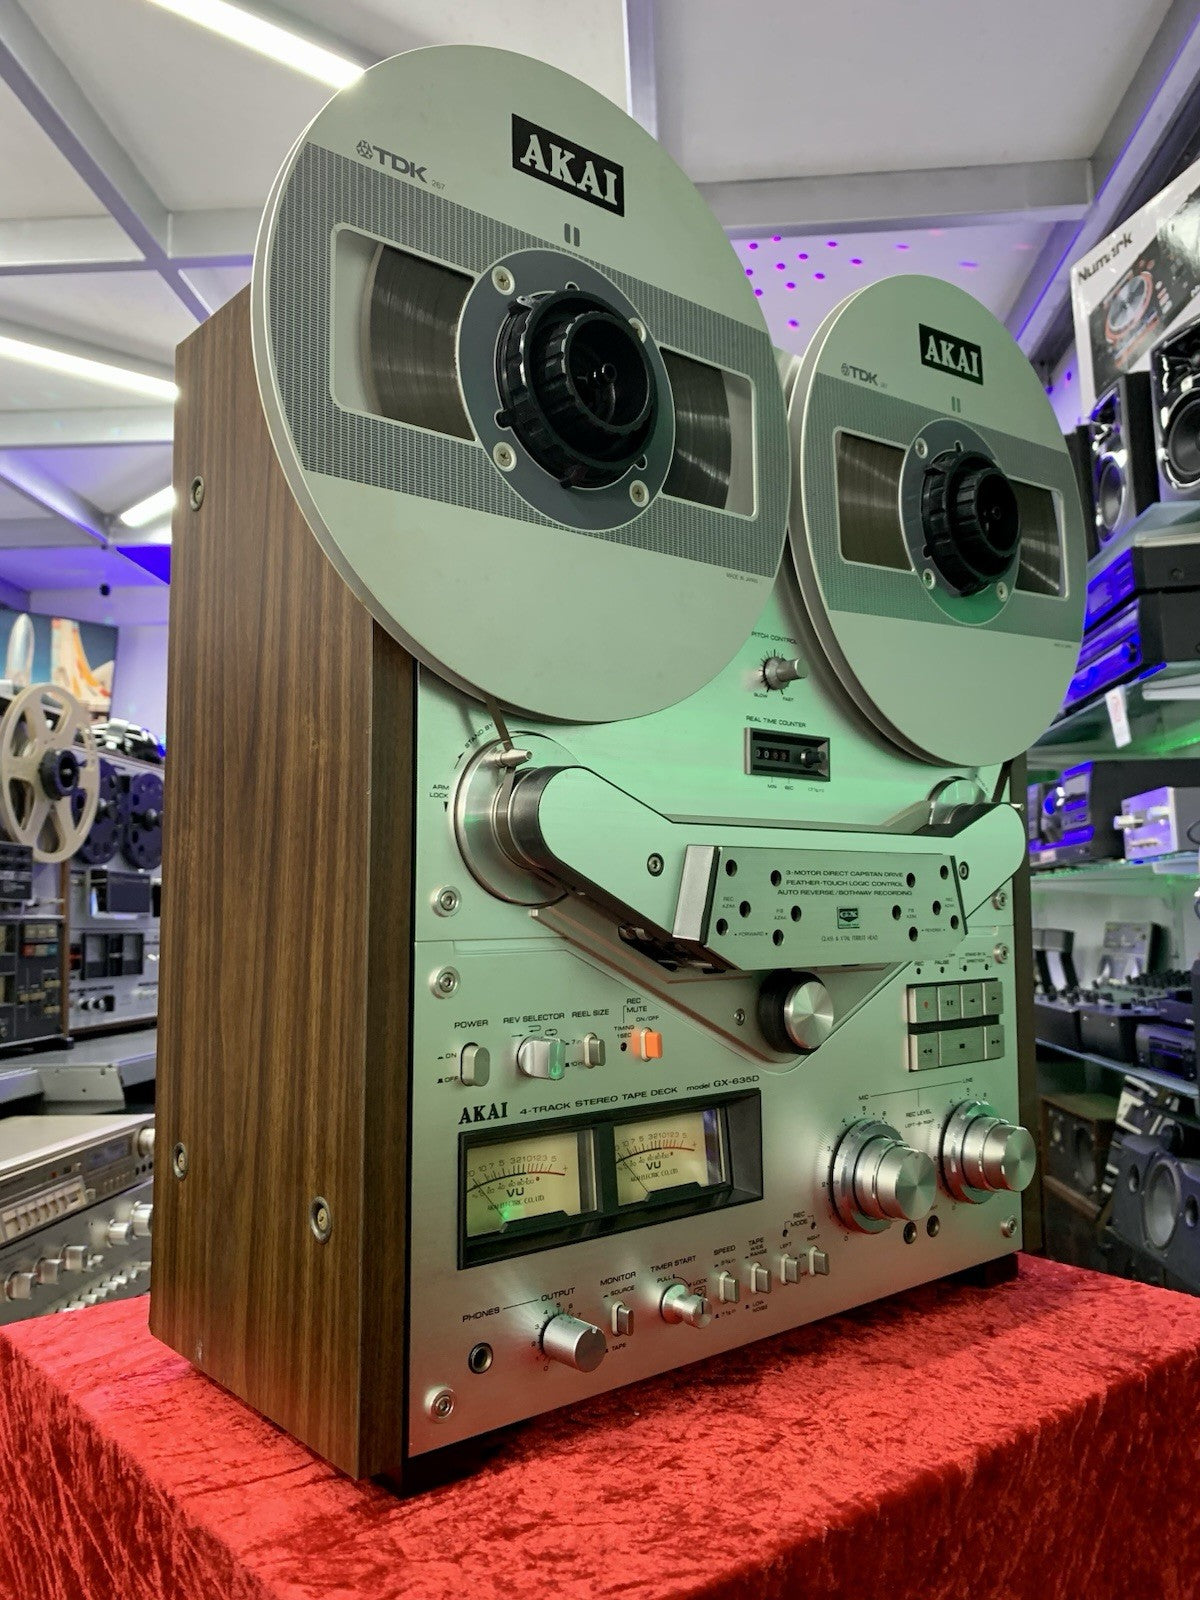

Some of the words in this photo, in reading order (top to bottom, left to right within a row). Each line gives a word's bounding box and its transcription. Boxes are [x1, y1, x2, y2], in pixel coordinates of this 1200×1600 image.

[373, 145, 427, 183] TDK
[520, 134, 617, 206] AKAI
[925, 335, 979, 378] AKAI
[849, 365, 878, 386] TDK
[751, 631, 769, 639] PITCH
[770, 635, 797, 644] CONTROL
[746, 715, 761, 723] REAL
[763, 717, 777, 725] TIME
[779, 719, 807, 728] COUNTER
[465, 728, 484, 749] STAND
[572, 1010, 591, 1018] REEL
[593, 1008, 610, 1016] SIZE
[627, 1005, 648, 1013] MUTE
[503, 1016, 521, 1024] REV
[522, 1012, 565, 1022] SELECTOR
[454, 1019, 489, 1029] POWER
[444, 1075, 459, 1083] OFF
[458, 1102, 508, 1125] AKAI
[519, 1102, 571, 1115] 4-TRACK
[575, 1095, 619, 1107] STEREO
[622, 1091, 647, 1100] TAPE
[650, 1086, 678, 1096] DECK
[687, 1082, 710, 1091] model
[713, 1075, 760, 1087] GX-635D
[646, 1161, 662, 1171] VU
[506, 1187, 524, 1198] VU
[790, 1219, 808, 1227] MODE
[748, 1236, 764, 1246] TAPE
[780, 1241, 792, 1249] LEFT
[714, 1244, 736, 1256] SPEED
[650, 1261, 673, 1273] TIMER
[674, 1255, 696, 1266] START
[600, 1271, 637, 1286] MONITOR
[657, 1275, 671, 1284] PULL
[693, 1277, 707, 1286] LOCK
[610, 1285, 635, 1296] SOURCE
[462, 1306, 500, 1322] PHONES
[541, 1287, 576, 1302] OUTPUT
[612, 1342, 626, 1351] TAPE
